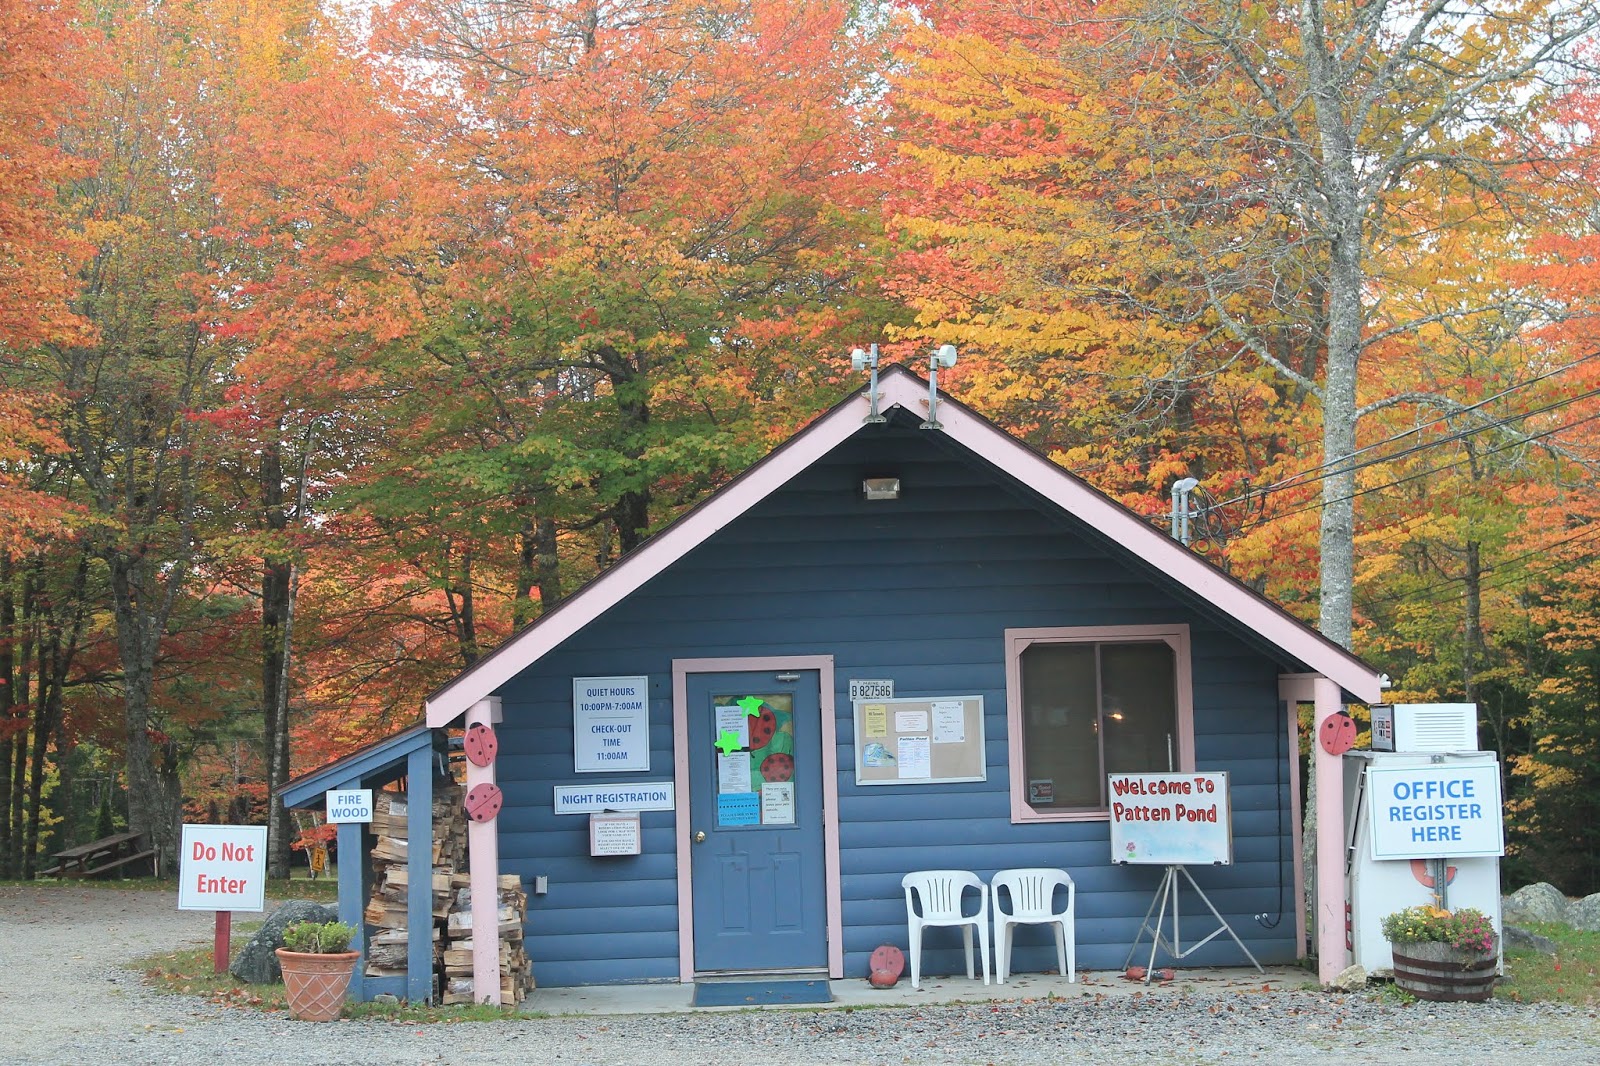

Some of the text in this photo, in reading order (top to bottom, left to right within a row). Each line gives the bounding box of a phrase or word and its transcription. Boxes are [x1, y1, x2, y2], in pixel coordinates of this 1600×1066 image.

[586, 687, 635, 698] QUIET HOURS
[852, 686, 890, 696] B 827586
[580, 702, 642, 711] 10:00PM-7:00AM
[591, 724, 632, 734] CHECK-OUT
[603, 738, 620, 747] TIME
[597, 752, 628, 761] 11:00AM
[1194, 778, 1214, 793] To
[1393, 780, 1475, 800] OFFICE
[338, 795, 362, 805] FIRE
[562, 791, 667, 804] NIGHT REGISTRATION
[332, 808, 368, 817] WOOD
[1113, 802, 1217, 823] Patten Pond
[1389, 804, 1481, 822] REGISTER
[1411, 826, 1461, 842] HERE
[193, 842, 254, 862] Do Not
[198, 874, 246, 894] Enter
